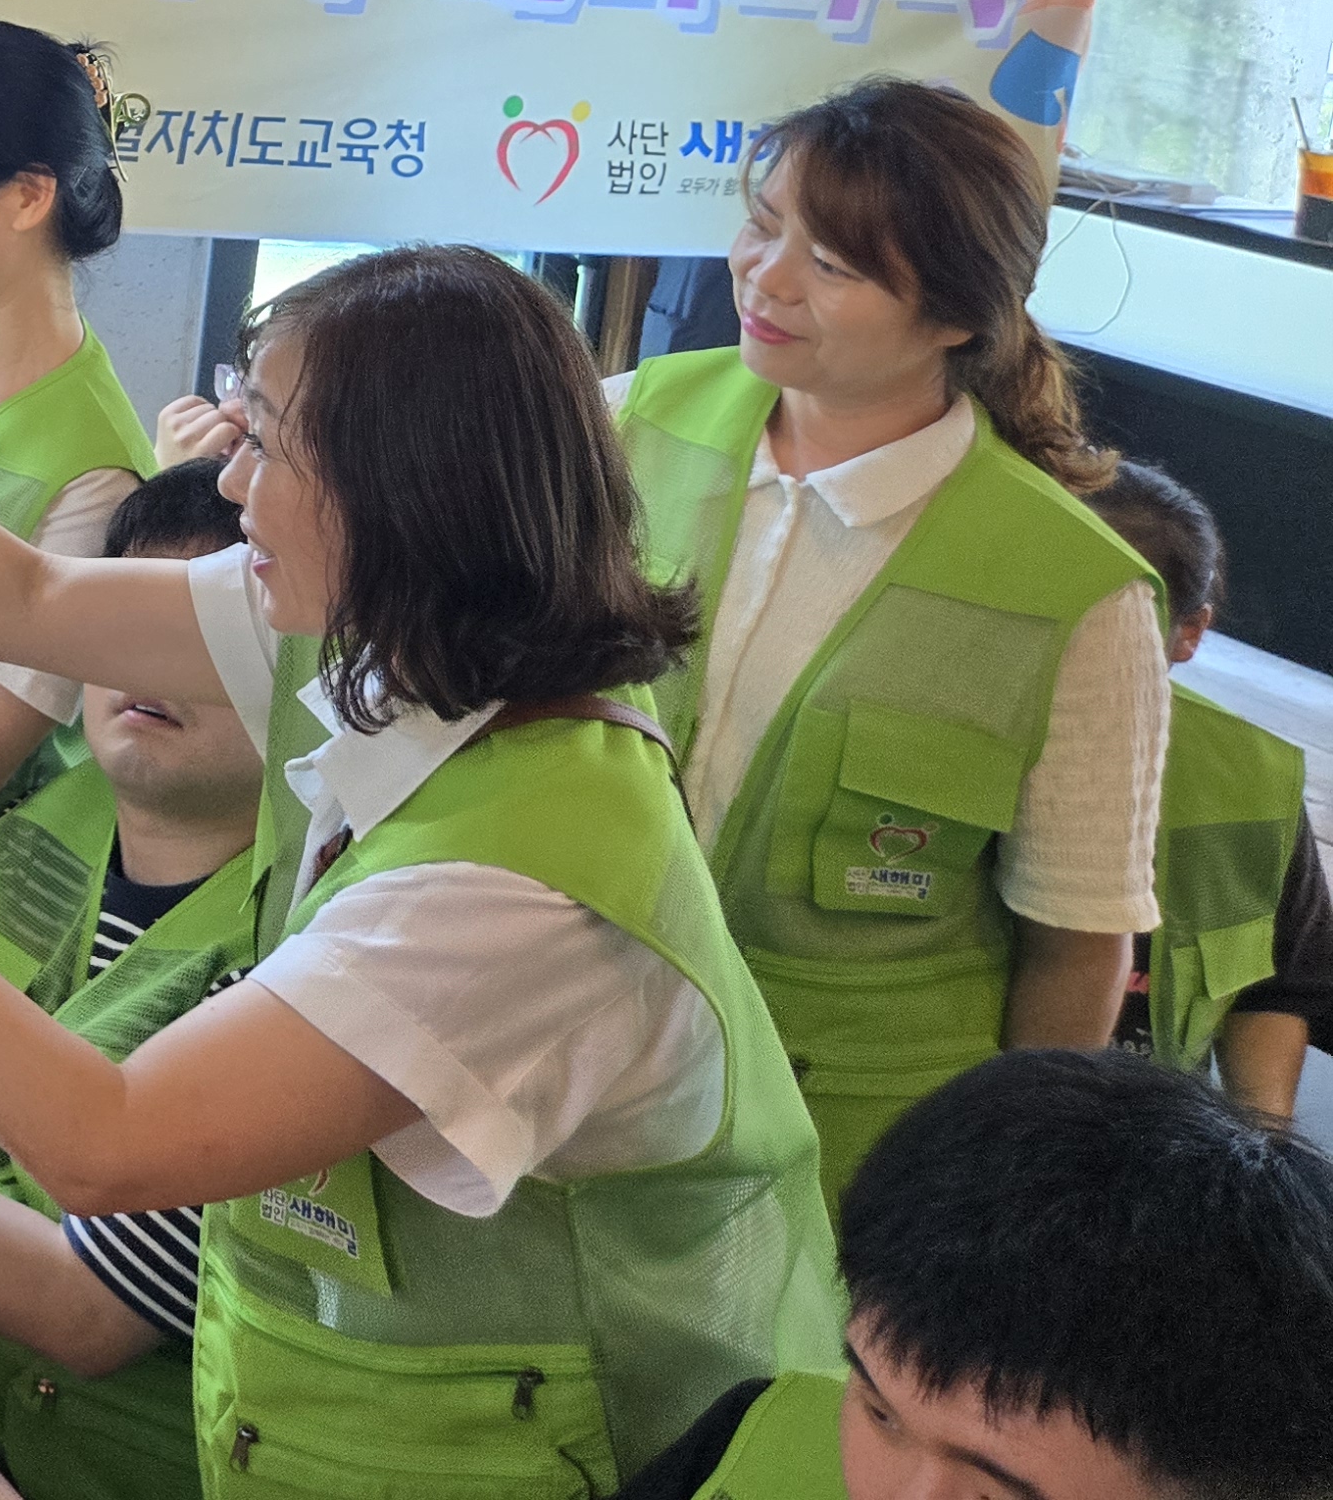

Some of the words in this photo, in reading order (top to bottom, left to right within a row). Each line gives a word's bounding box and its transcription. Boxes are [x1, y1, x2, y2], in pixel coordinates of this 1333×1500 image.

[607, 119, 670, 157] 사단
[679, 119, 775, 164] 새
[607, 160, 668, 195] 법인
[675, 177, 721, 196] 모두가
